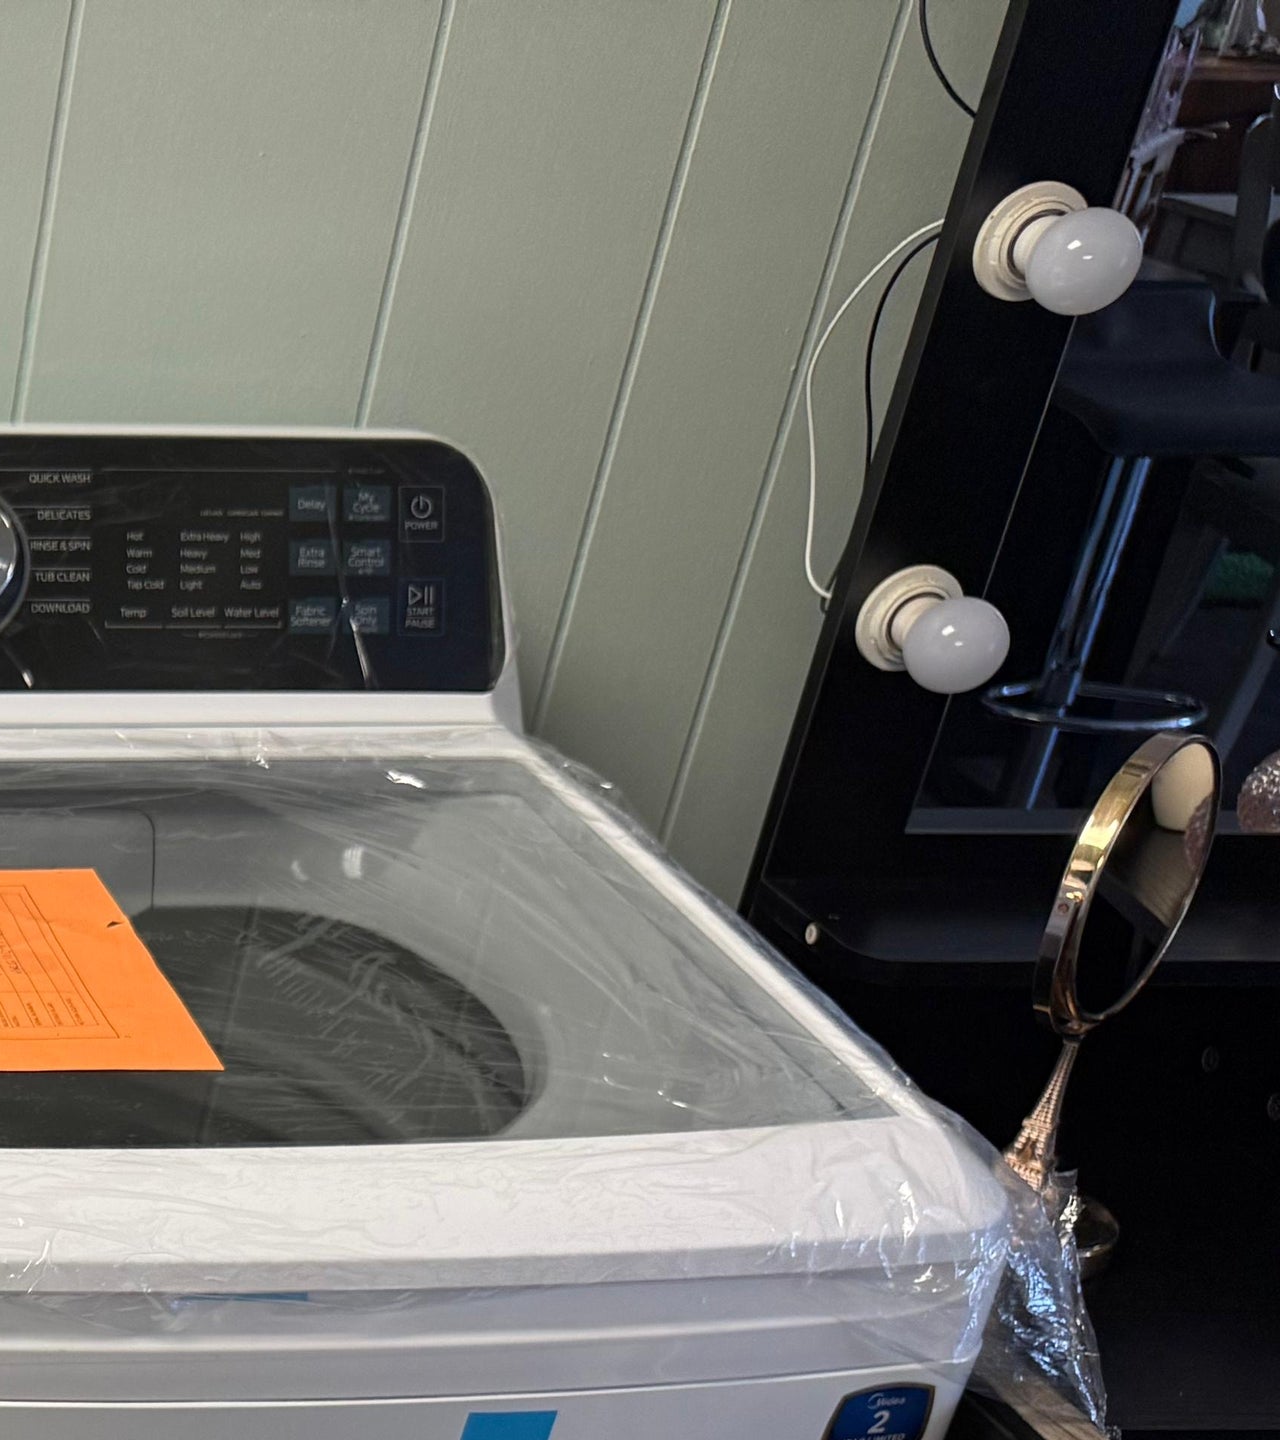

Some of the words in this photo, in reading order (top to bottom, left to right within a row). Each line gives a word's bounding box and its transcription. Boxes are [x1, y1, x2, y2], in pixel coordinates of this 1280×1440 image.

[28, 472, 60, 484] QUICK
[60, 472, 92, 484] WASH
[36, 510, 92, 521] DELICATES
[404, 521, 438, 531] POWER
[30, 540, 58, 551] RINSE
[68, 541, 92, 551] SPIN
[348, 557, 385, 568] Control
[35, 571, 56, 582] TUB
[56, 571, 91, 583] CLEAN
[31, 602, 91, 614] DOWNLOAD
[120, 607, 148, 619] Temp
[171, 607, 189, 618] Soil
[190, 607, 217, 618] Level
[224, 607, 253, 618] Water
[254, 607, 280, 618] Level
[406, 607, 436, 616] START
[404, 618, 436, 629] PAUSE
[866, 1410, 890, 1435] 2
